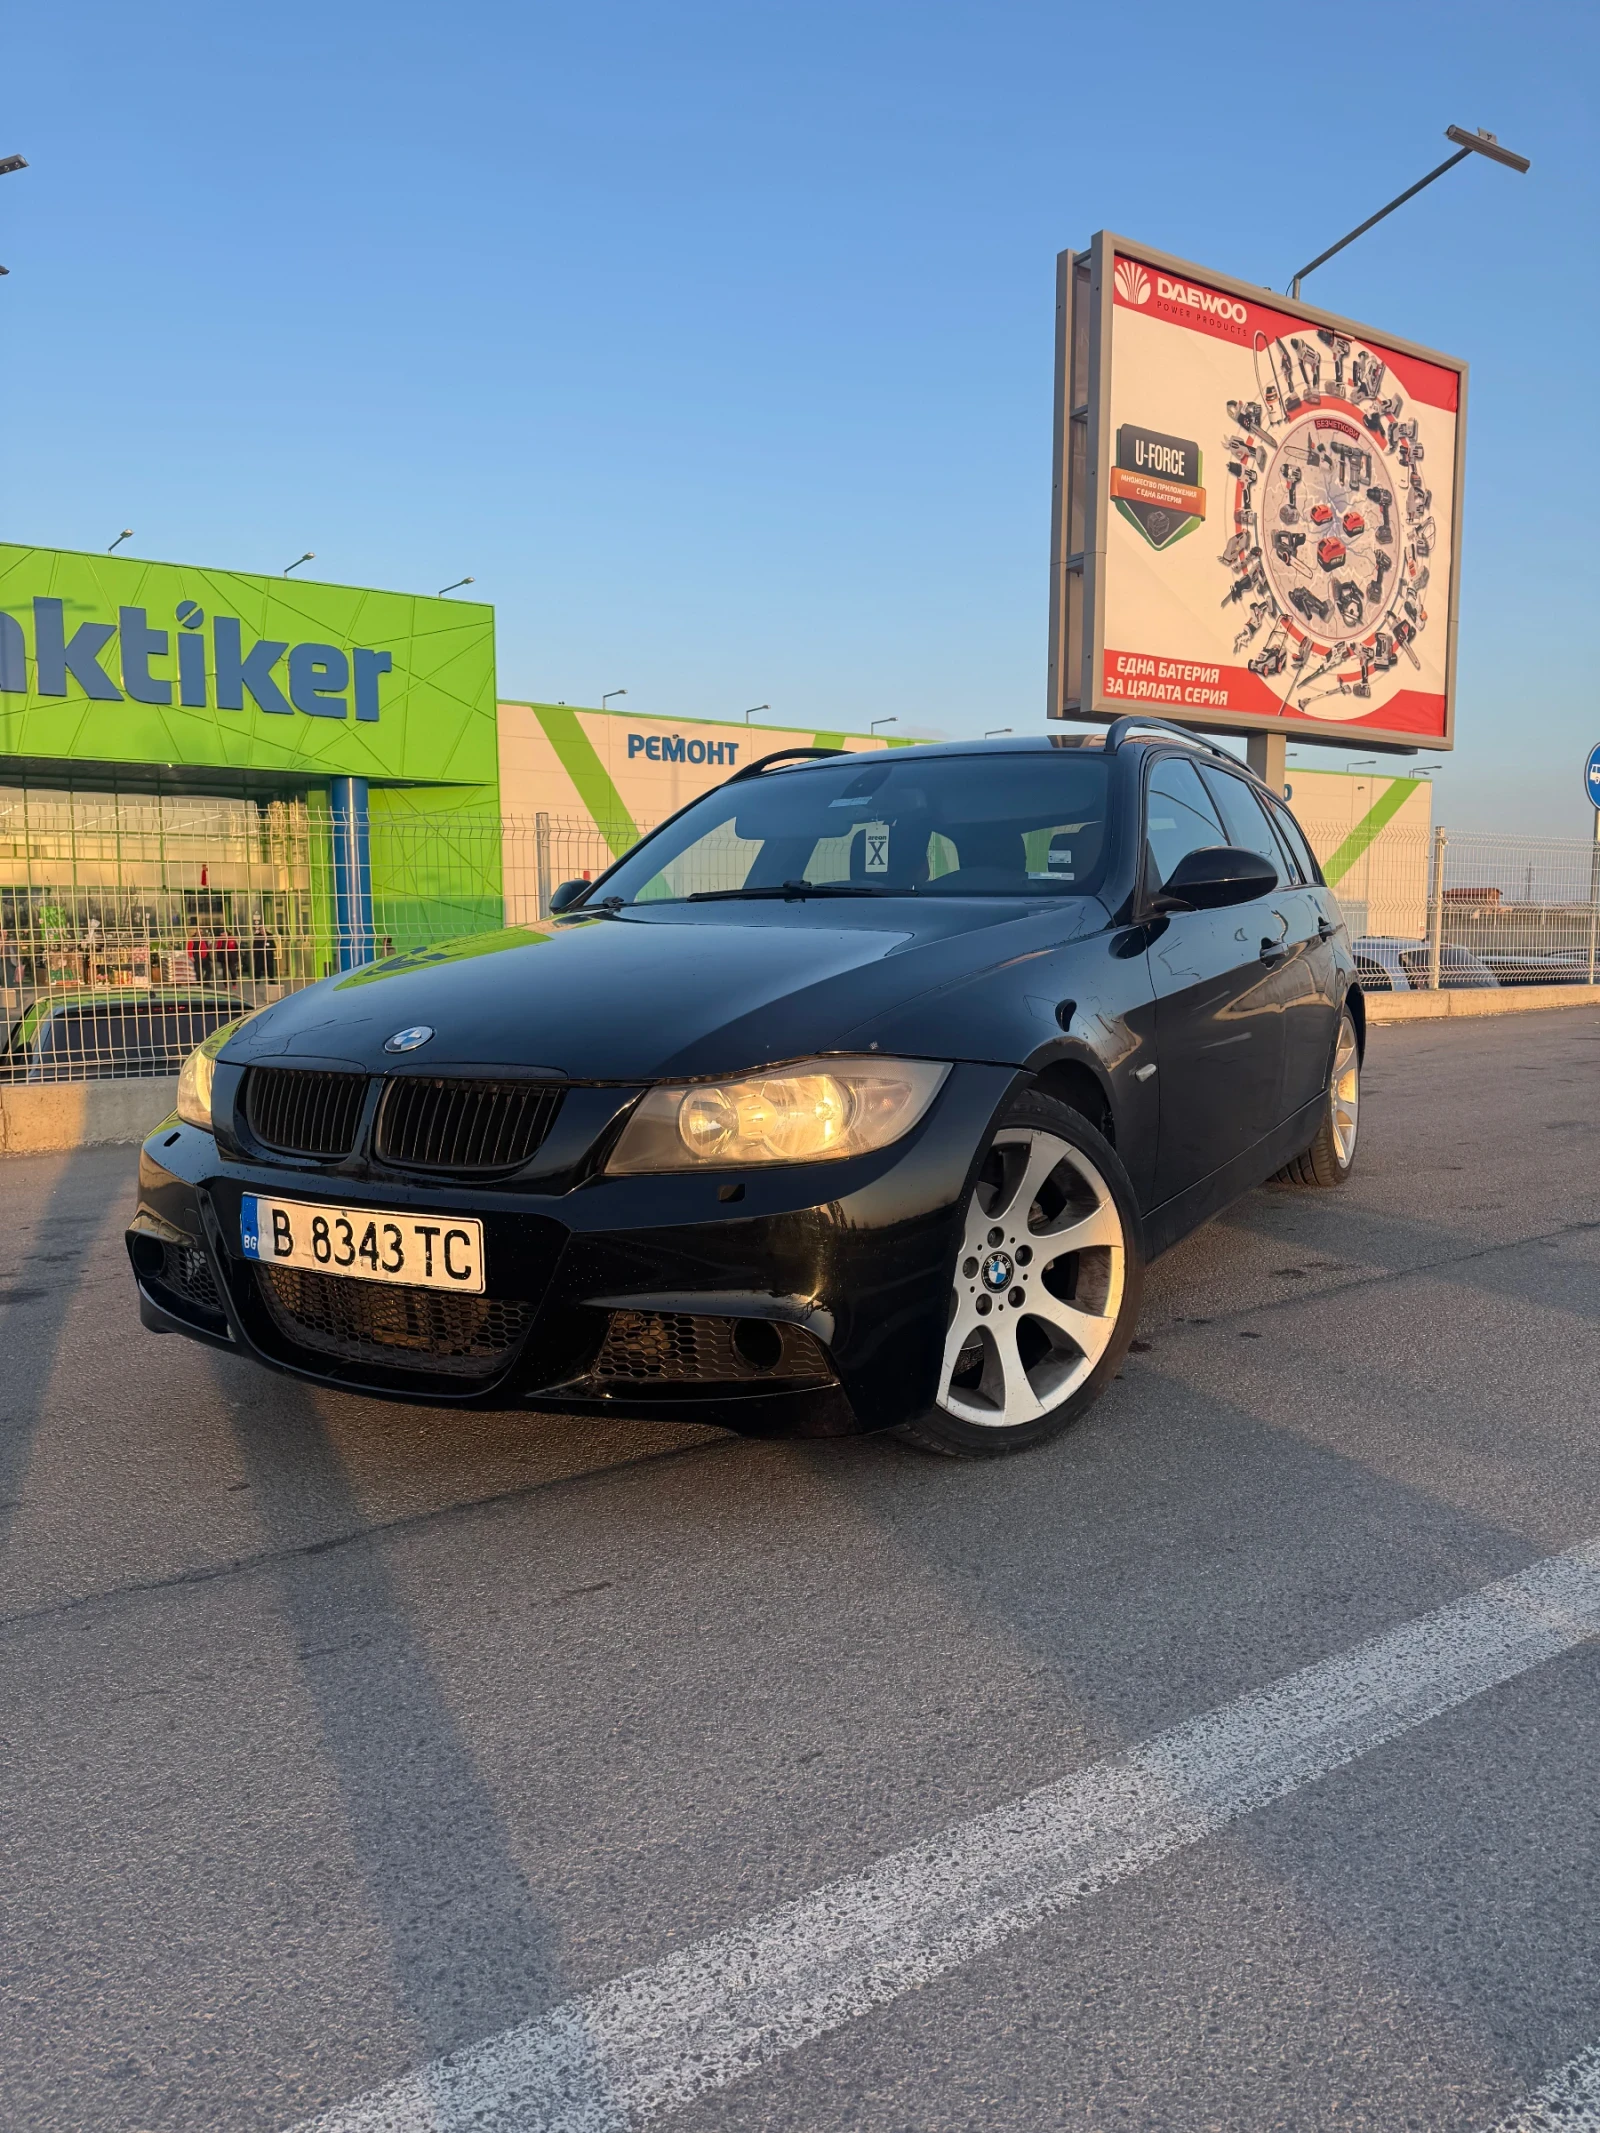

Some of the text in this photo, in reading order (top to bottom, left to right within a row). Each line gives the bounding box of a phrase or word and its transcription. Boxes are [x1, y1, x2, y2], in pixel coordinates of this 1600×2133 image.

[1157, 277, 1247, 324] DAEWOO
[1157, 301, 1247, 337] POWER PRODUCTS
[1316, 419, 1359, 440] БЕЗЧЕТКОВИ
[1135, 439, 1185, 477] U-FORCE
[1120, 474, 1198, 499] МНОЖЕСТВО ПРИЛОЖЕНИЯ
[1141, 489, 1156, 499] ЕДНА
[1156, 493, 1182, 505] БАТЕРИЯ
[1117, 656, 1220, 684] ЕДНА БАТЕРИЯ
[1106, 677, 1229, 706] ЗА ЦЯЛАТА СЕРИЯ
[627, 733, 739, 766] РЕМОНТ
[867, 841, 887, 866] X
[244, 1235, 257, 1250] BG
[312, 1216, 406, 1274] 8343
[414, 1225, 472, 1281] TC
[984, 1255, 1012, 1269] BMW
